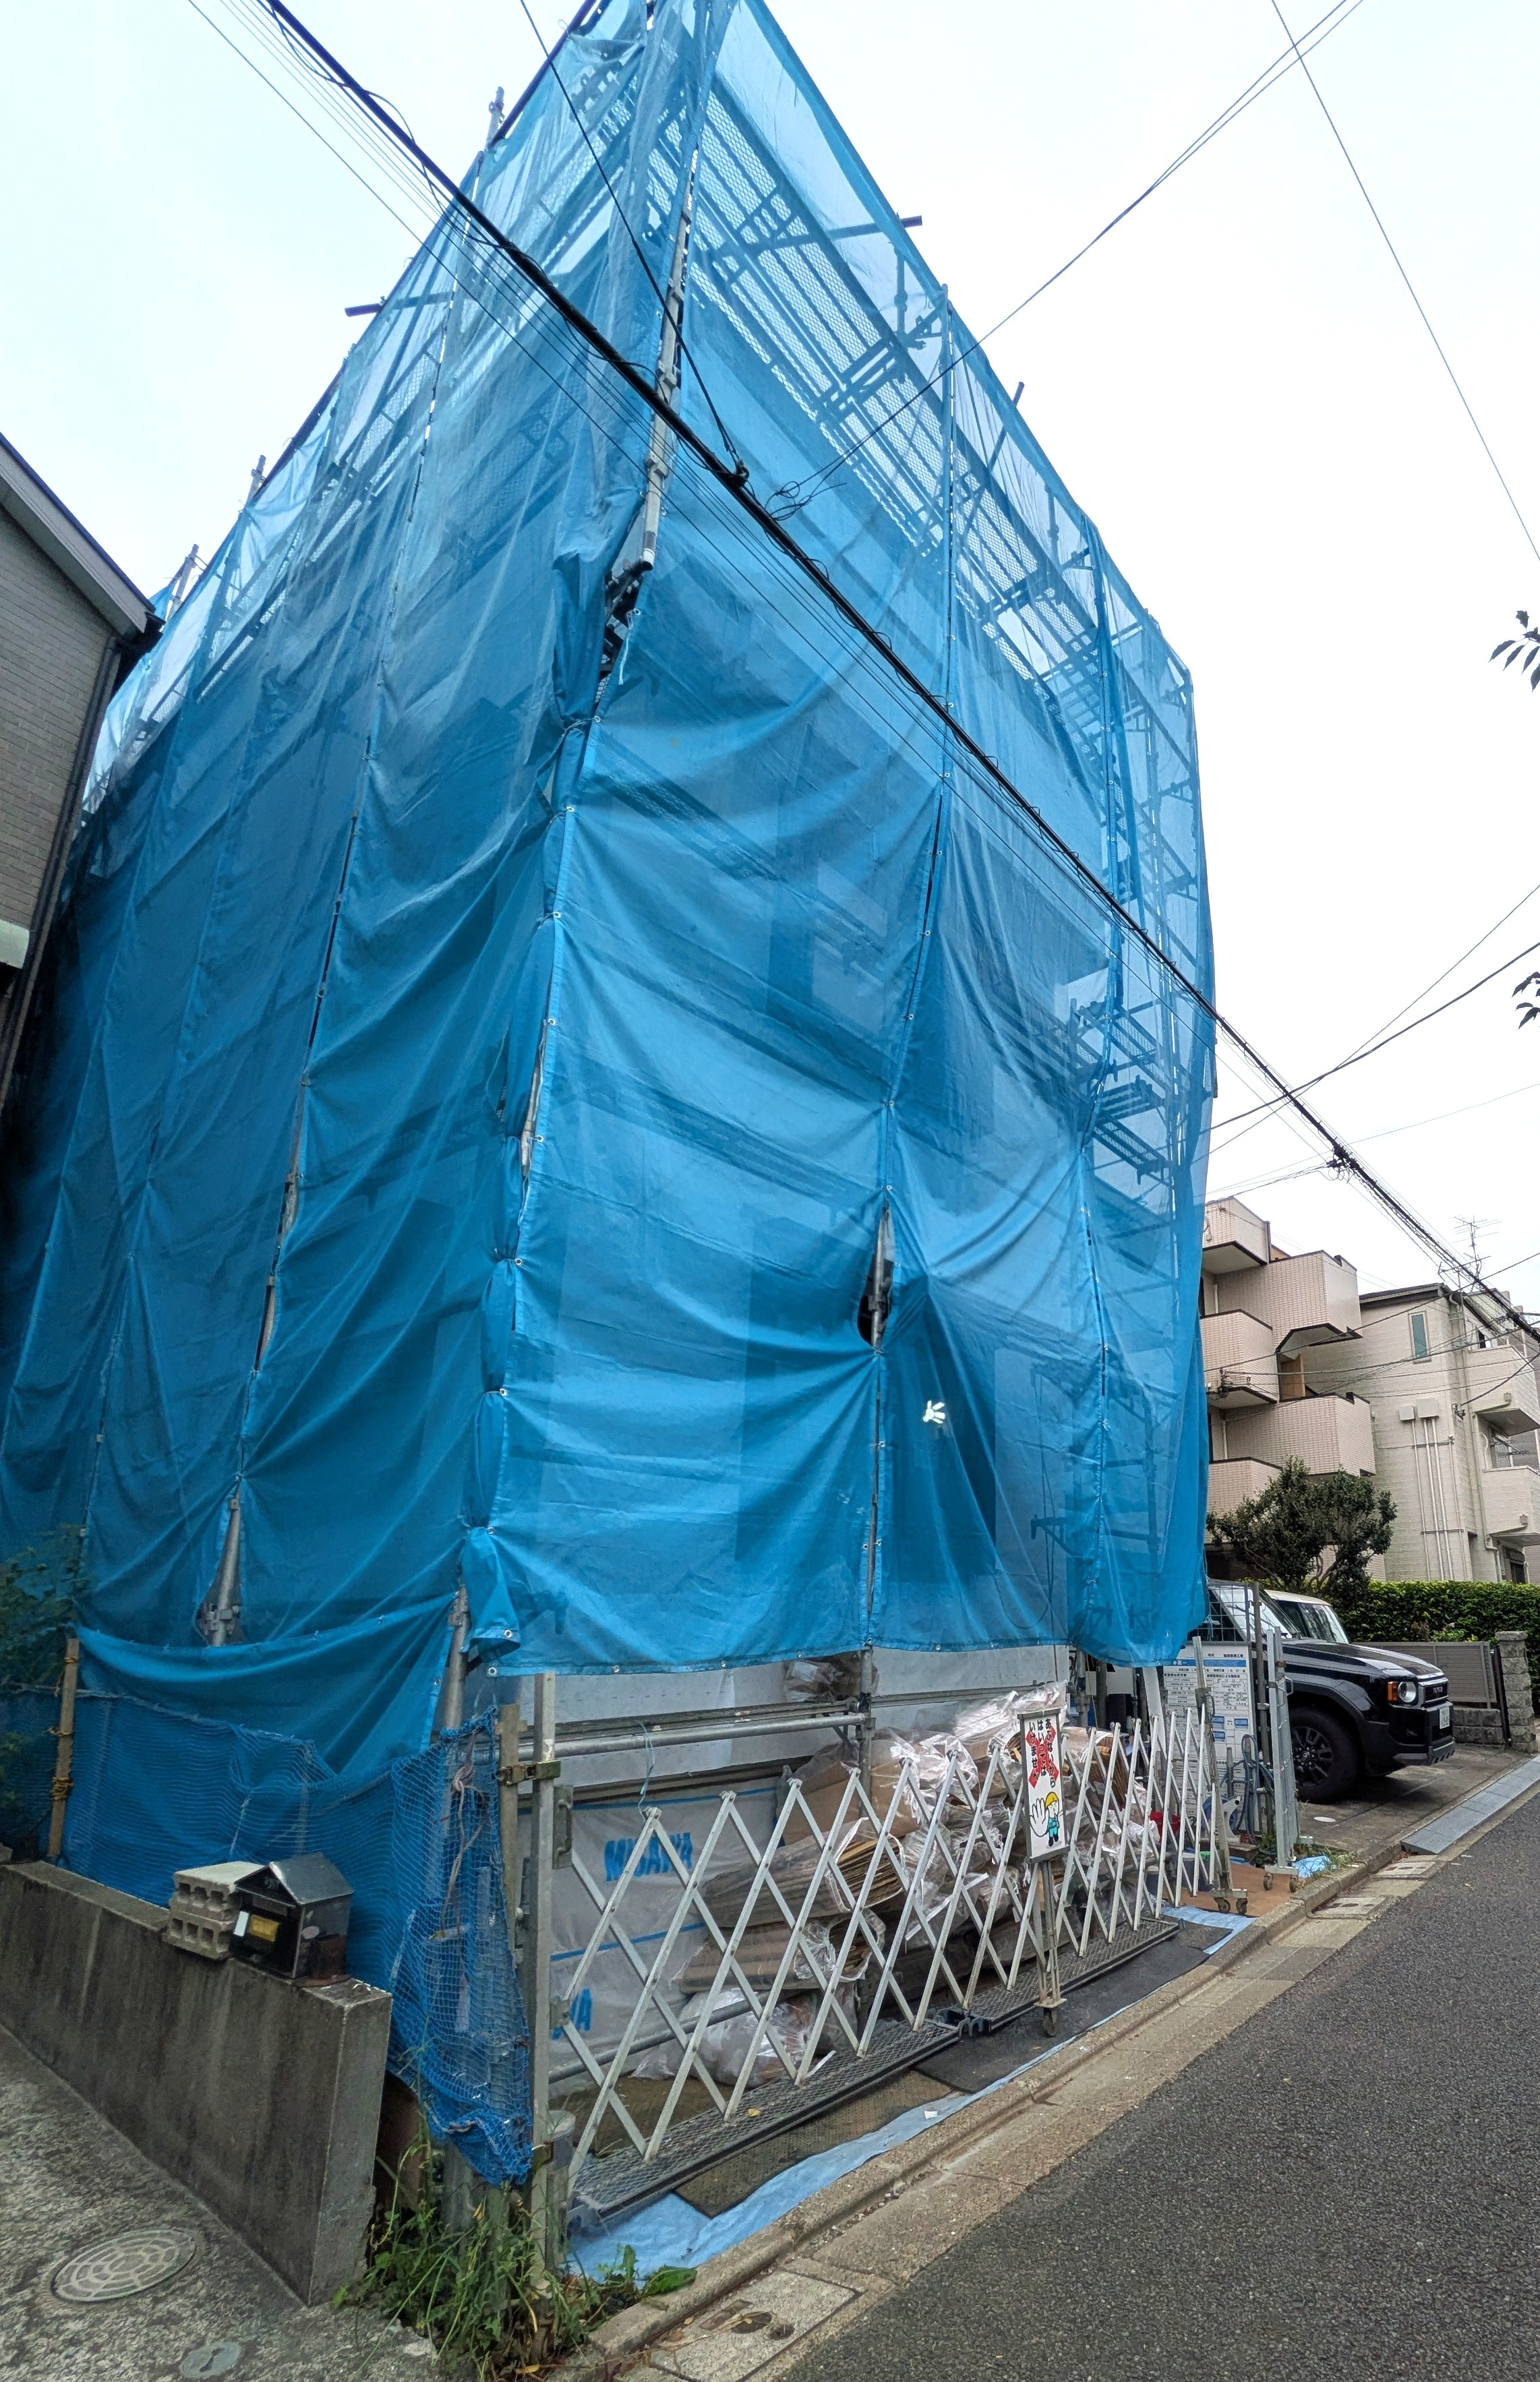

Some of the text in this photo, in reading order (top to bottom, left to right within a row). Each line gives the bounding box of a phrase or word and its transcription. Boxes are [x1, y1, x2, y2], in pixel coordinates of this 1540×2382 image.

[1029, 1722, 1040, 1781] いけません
[1037, 1720, 1047, 1777] はいっては
[1045, 1719, 1056, 1788] あぶないから
